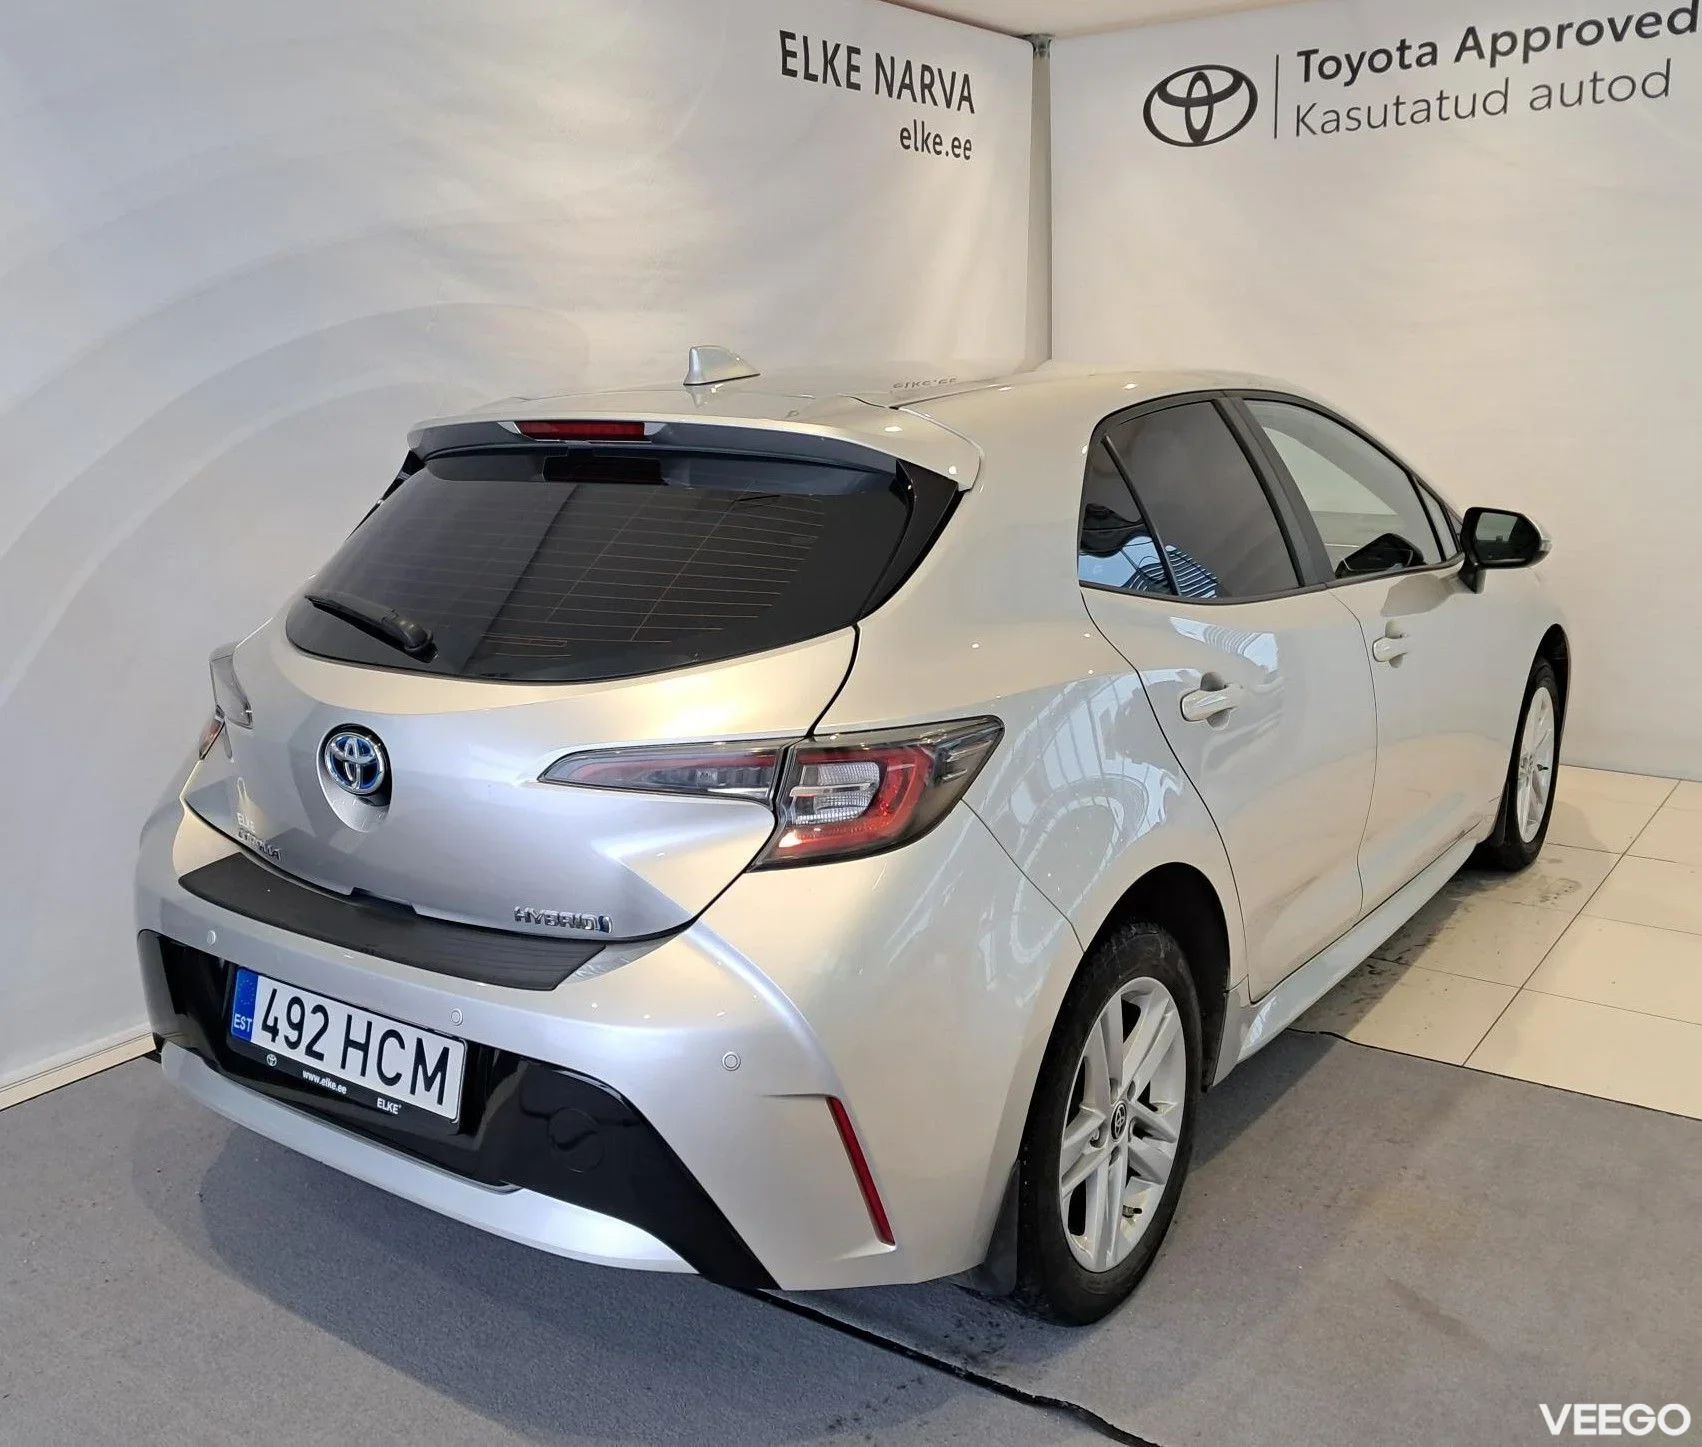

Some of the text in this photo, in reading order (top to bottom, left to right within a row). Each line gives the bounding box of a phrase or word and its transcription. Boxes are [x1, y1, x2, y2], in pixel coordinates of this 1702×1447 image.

[779, 29, 975, 114] ELKE NARVA
[1297, 0, 1700, 87] Toyota Approved
[1296, 58, 1672, 137] Kasutatud autod
[899, 118, 972, 160] elke.ee
[513, 905, 598, 931] HYBRID
[233, 1012, 253, 1033] EST
[261, 988, 450, 1106] 492 HCM
[302, 1069, 348, 1095] www.elke.ee
